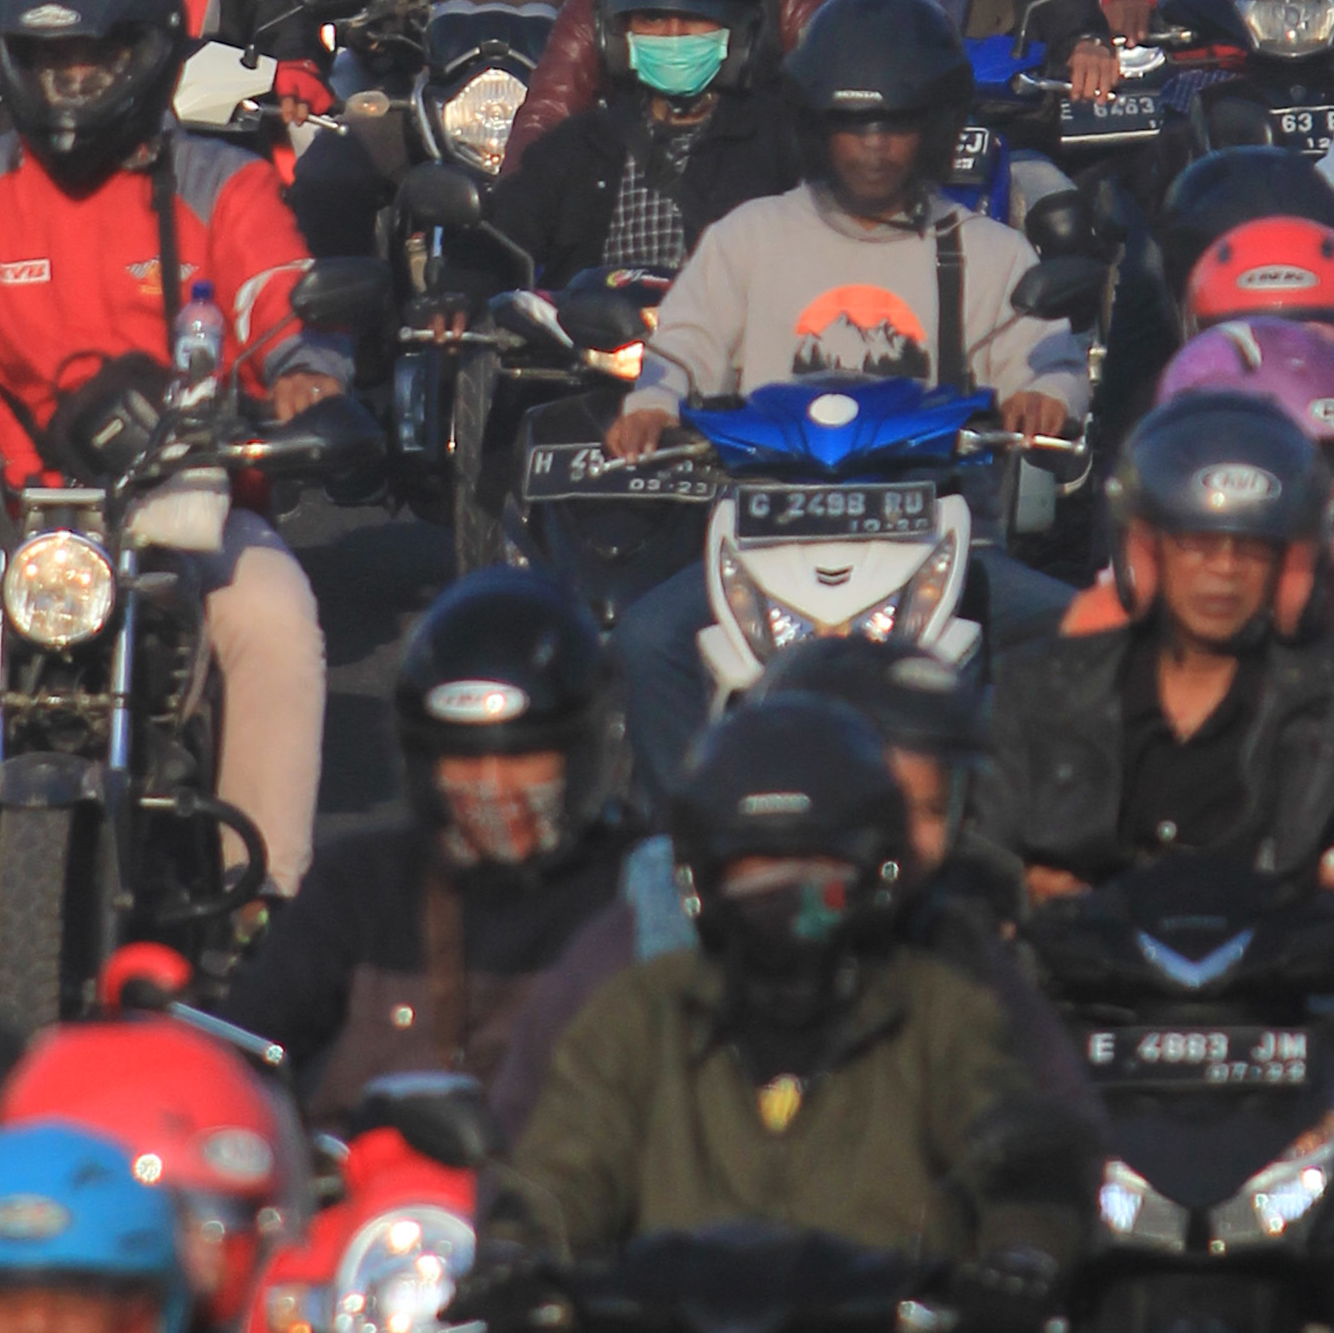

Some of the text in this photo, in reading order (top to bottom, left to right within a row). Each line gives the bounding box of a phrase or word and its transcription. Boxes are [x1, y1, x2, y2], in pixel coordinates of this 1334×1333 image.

[1281, 113, 1313, 133] 63
[534, 451, 554, 475] H
[1090, 1033, 1116, 1064] E
